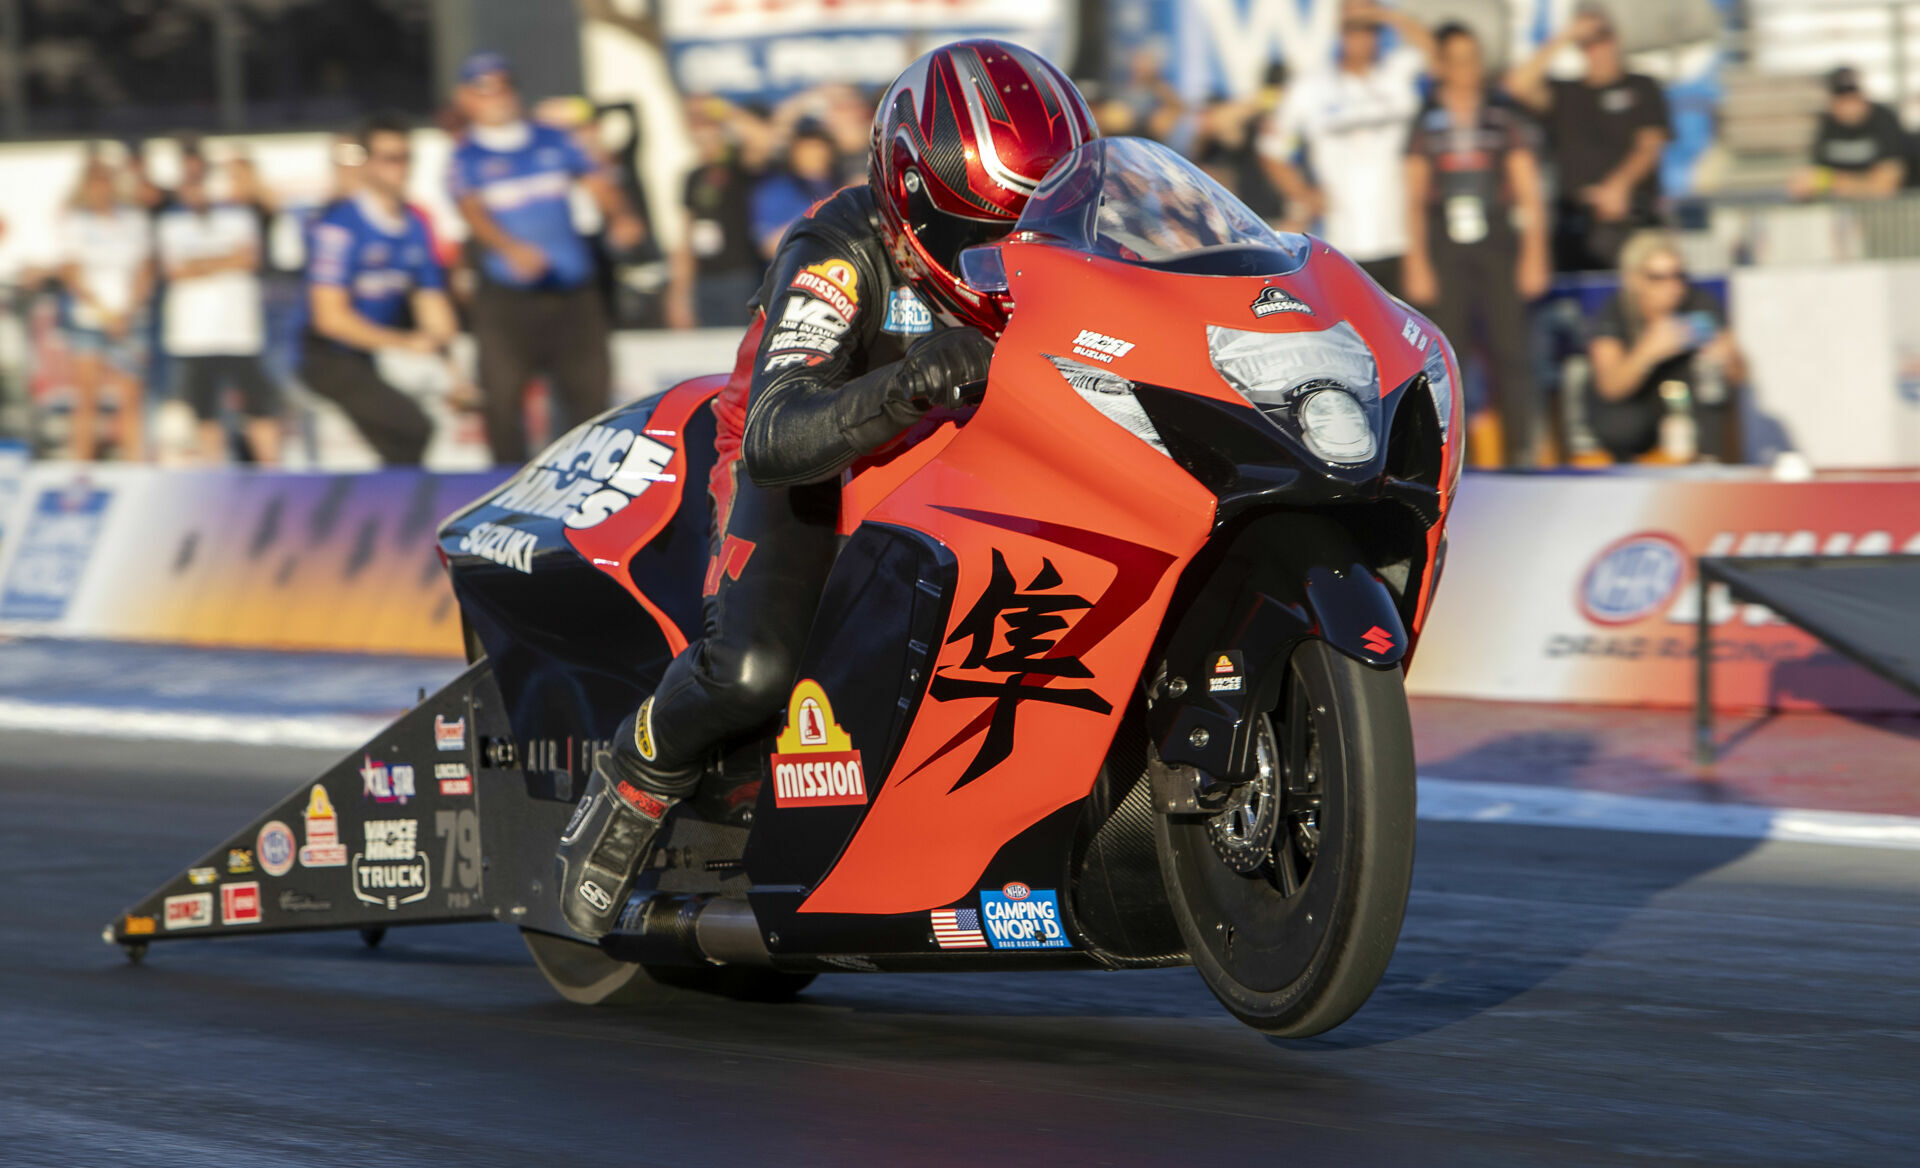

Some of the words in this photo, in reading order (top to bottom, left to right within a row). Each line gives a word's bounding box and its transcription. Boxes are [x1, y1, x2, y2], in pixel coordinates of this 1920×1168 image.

[795, 272, 856, 320] MISSION
[1255, 301, 1312, 315] MISSION
[1072, 346, 1114, 364] SUZUKI
[459, 522, 539, 575] SUZUKI
[928, 547, 1114, 796] 隼
[527, 739, 557, 772] AIR
[775, 760, 864, 799] MISSION
[364, 818, 418, 841] VANCE
[365, 839, 417, 861] HINES
[435, 810, 481, 888] 79
[358, 864, 424, 888] TRUCK
[1005, 885, 1028, 899] NHRA
[985, 901, 1055, 920] CAMPING
[987, 919, 1063, 940] WORLD
